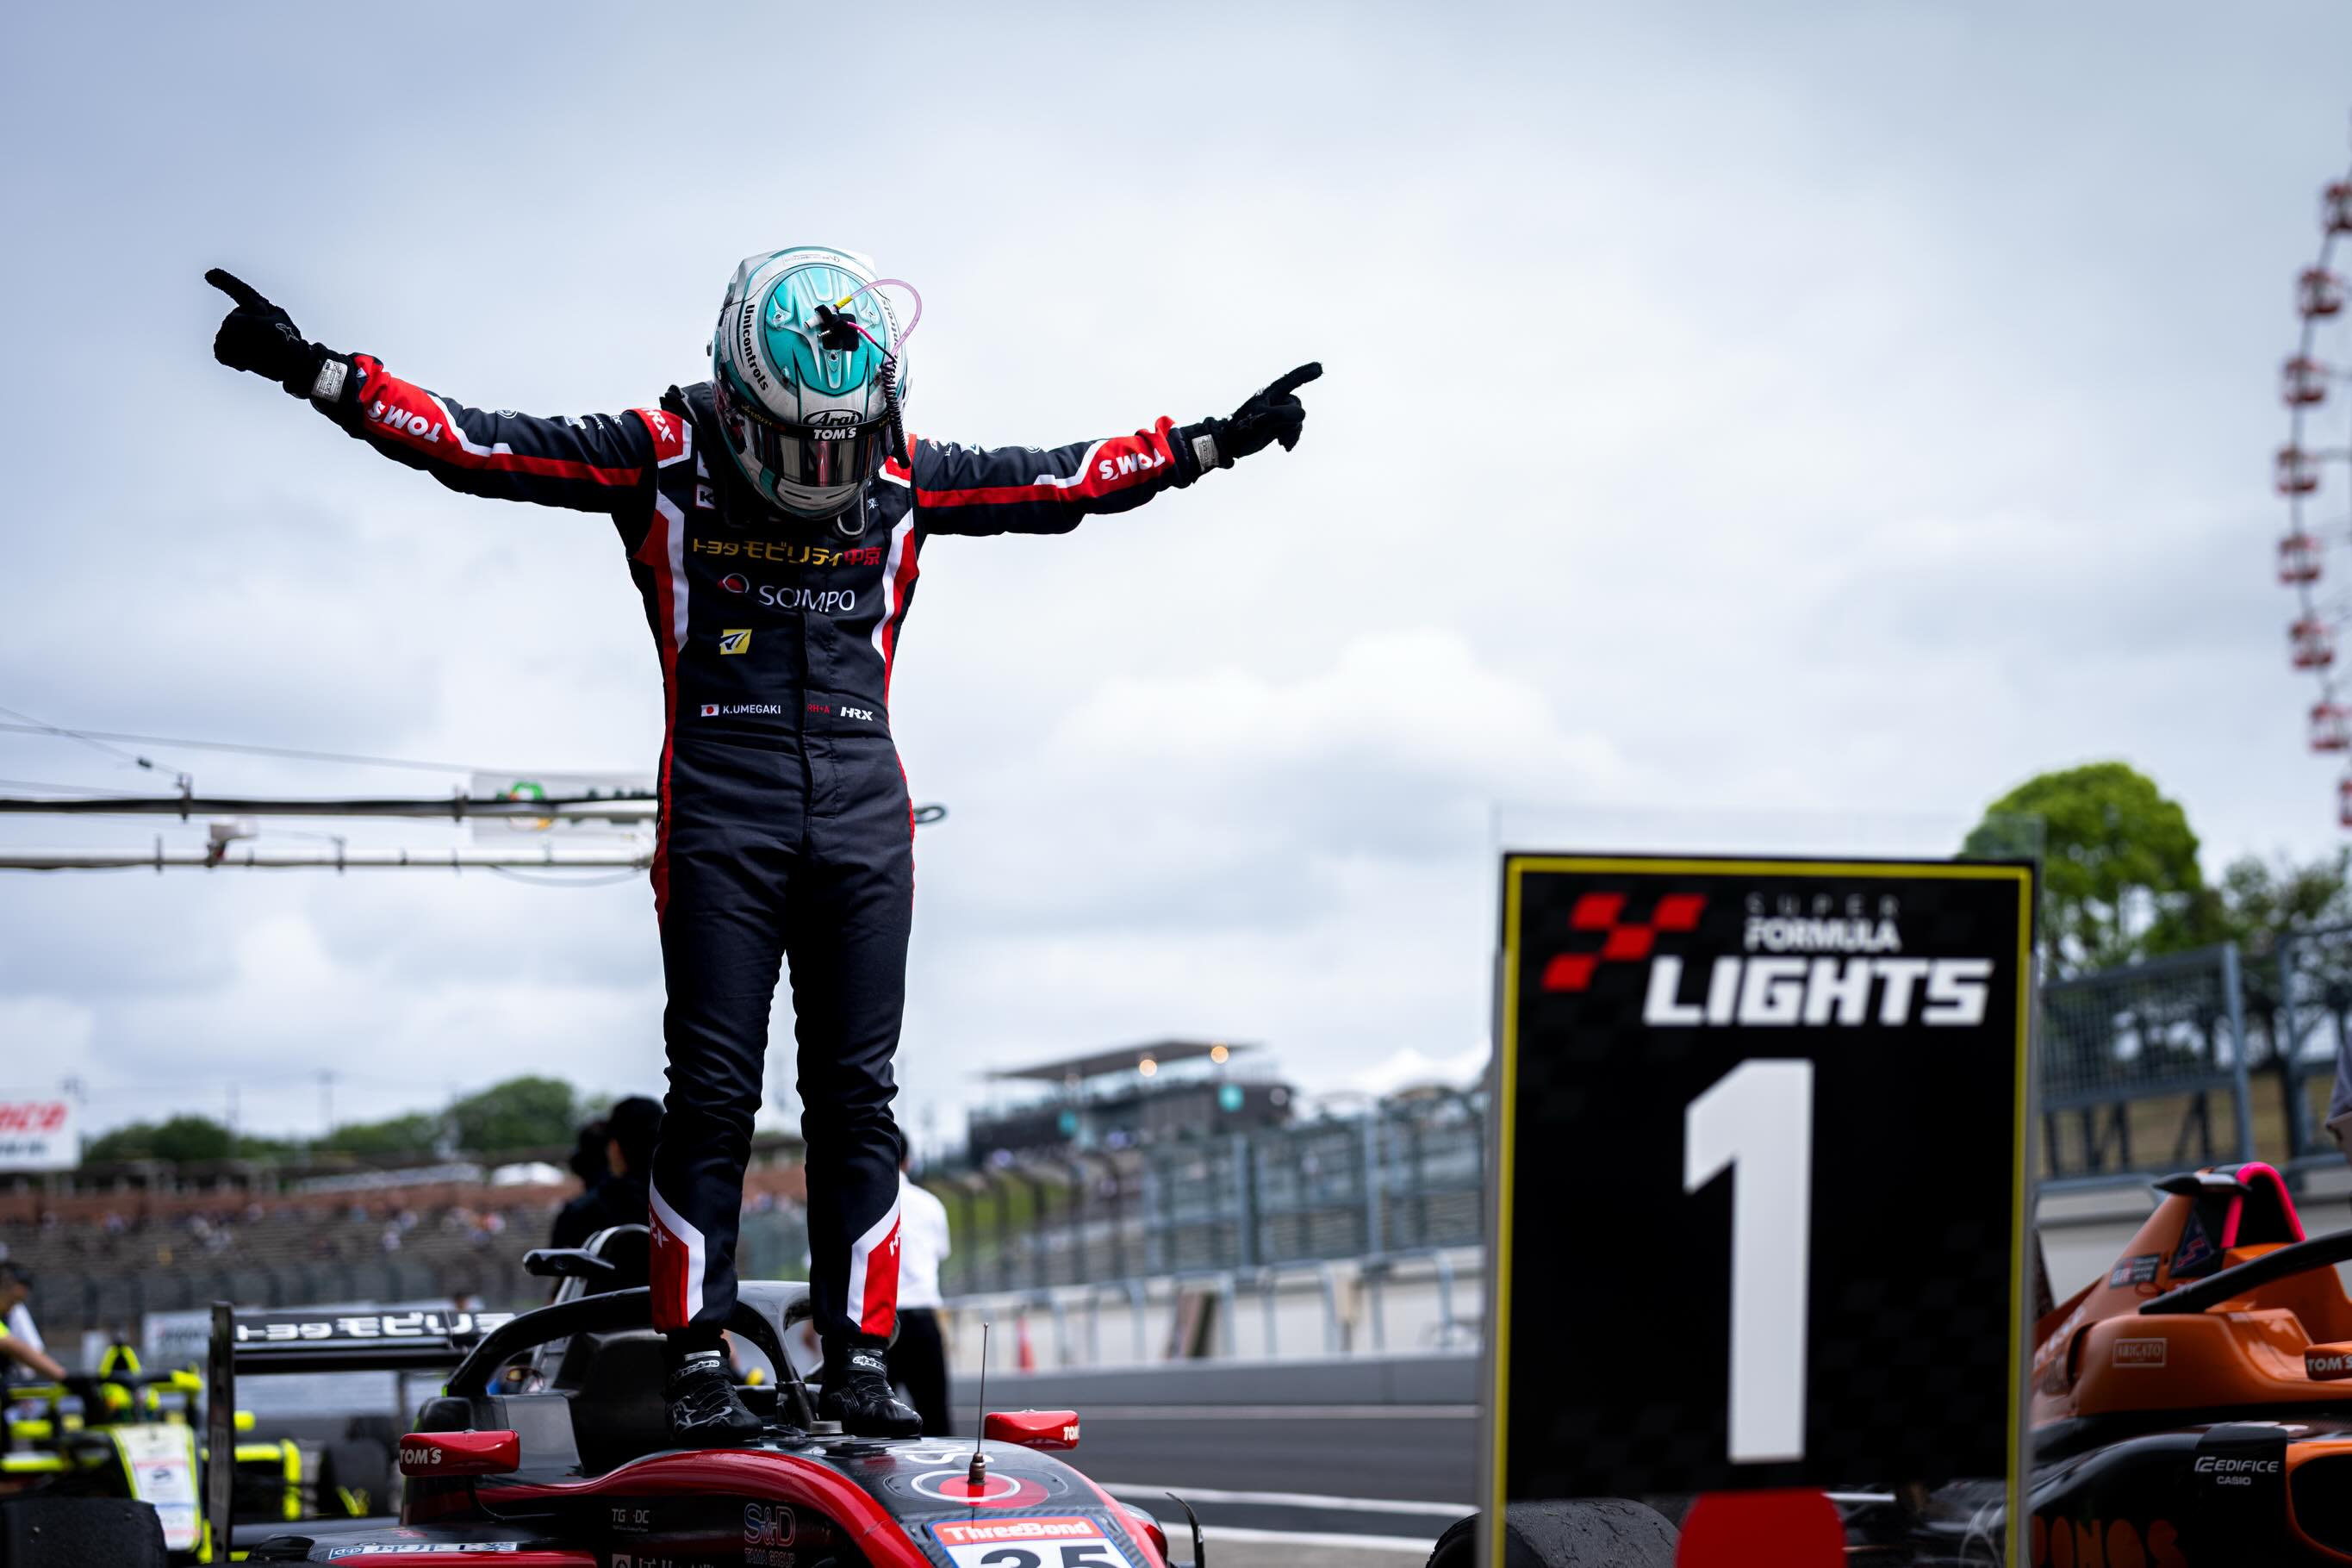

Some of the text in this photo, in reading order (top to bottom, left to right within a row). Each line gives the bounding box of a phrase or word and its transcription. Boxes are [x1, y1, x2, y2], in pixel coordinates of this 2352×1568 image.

[742, 304, 768, 391] Unicontrols
[814, 412, 856, 426] Arai
[813, 427, 857, 440] TOM'S
[758, 585, 856, 613] SOMPO
[723, 704, 781, 715] K.UMEGAKI
[841, 706, 874, 721] HRX
[1745, 893, 1899, 916] SUPER
[1745, 918, 1901, 953] FORMULA
[1643, 956, 1994, 1027] LIGHTS
[1683, 1057, 1814, 1464] 1
[399, 1447, 442, 1465] TOM'S
[2216, 1475, 2252, 1486] CASIO
[744, 1503, 796, 1547] S&D
[943, 1521, 1092, 1541] ThreeBond
